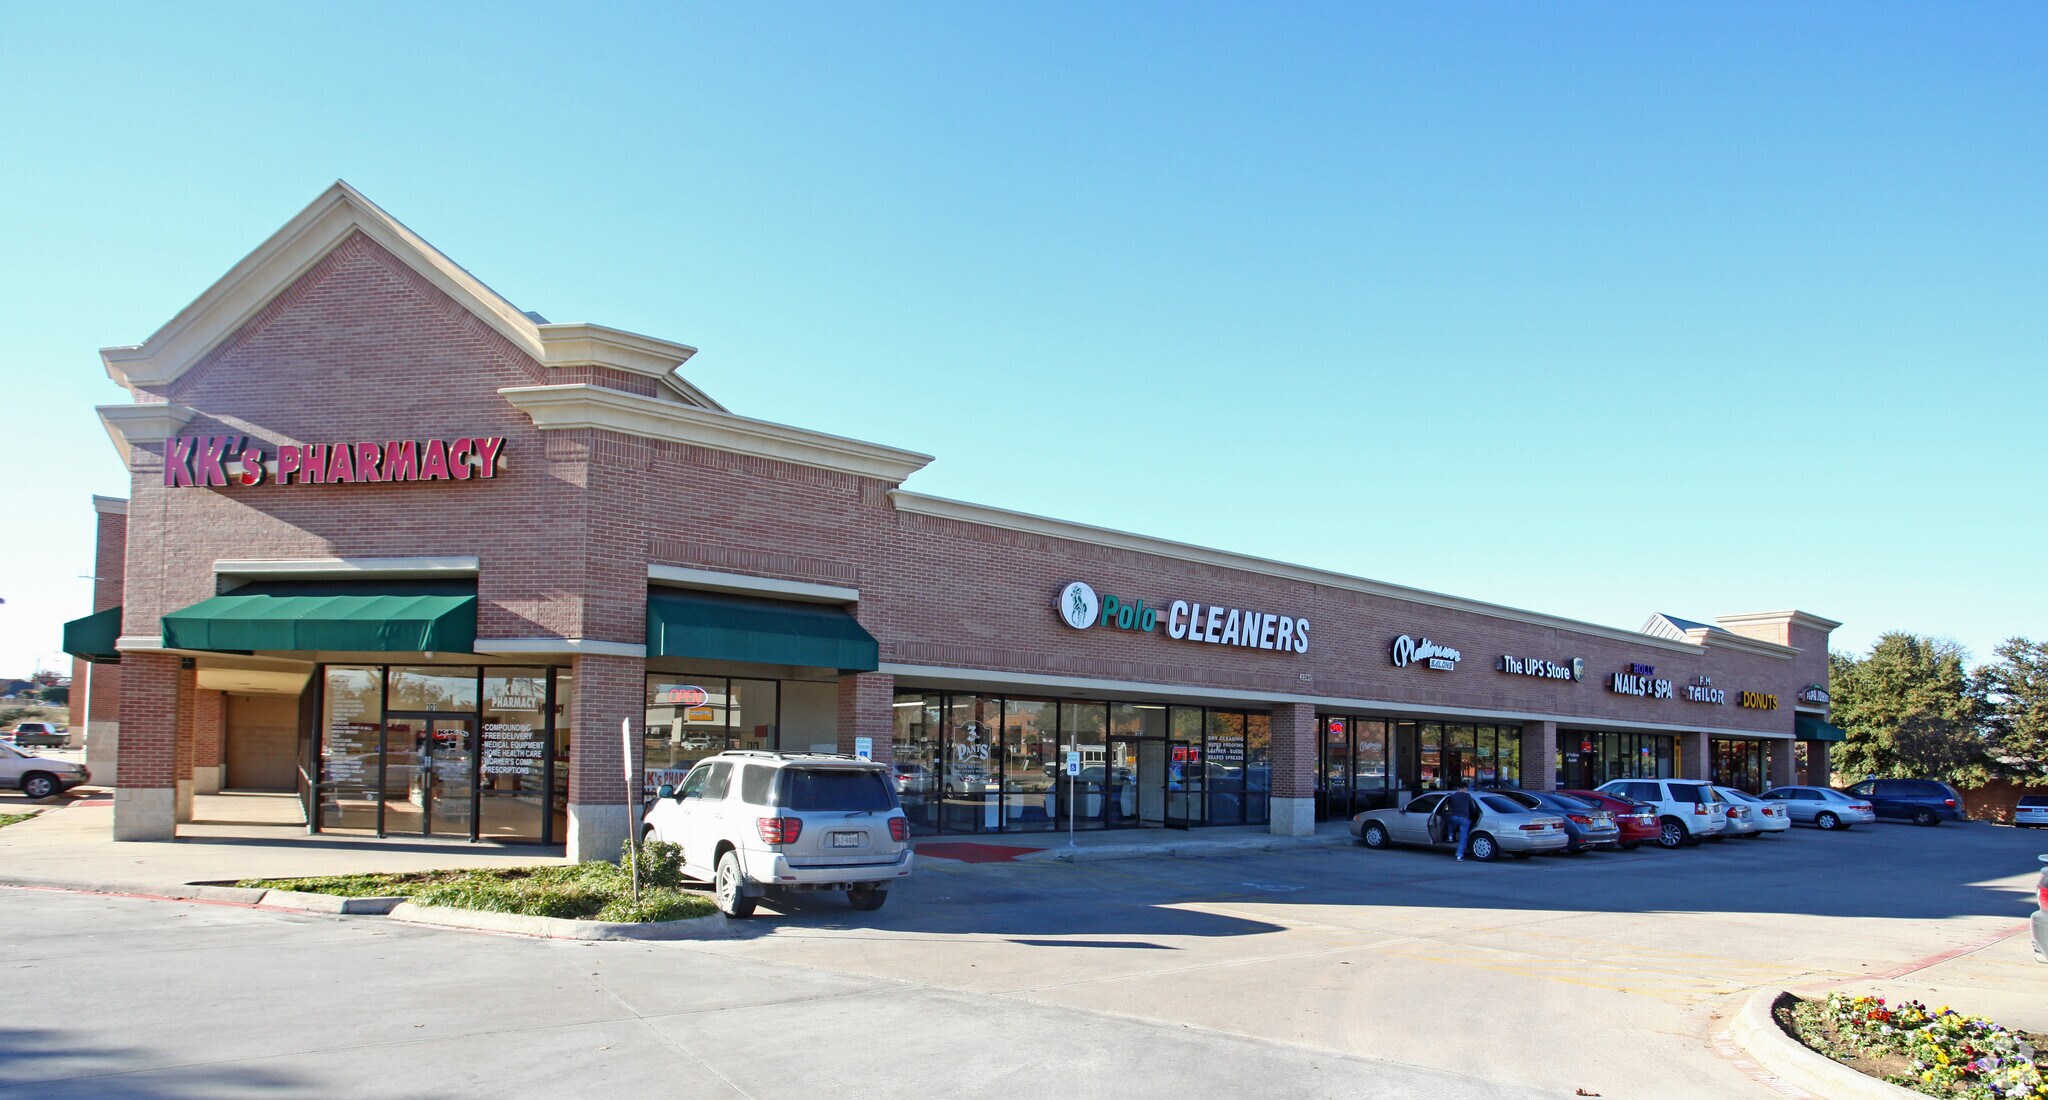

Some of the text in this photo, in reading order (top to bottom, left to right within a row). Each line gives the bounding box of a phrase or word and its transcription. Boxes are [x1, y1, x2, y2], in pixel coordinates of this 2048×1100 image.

[164, 435, 504, 487] KK's PHARMACY
[1101, 594, 1310, 654] Polo CLEANERS
[1394, 635, 1460, 667] Platinum
[1430, 660, 1453, 669] SALONS
[1504, 655, 1571, 679] The UPS Store
[1634, 664, 1655, 675] HOLLY
[1614, 673, 1672, 699] NAILS & SPA
[1699, 676, 1713, 686] F.H.
[491, 696, 537, 708] PHARMACY
[669, 688, 703, 704] OPEN
[1688, 685, 1725, 705] TAILOR
[1743, 691, 1778, 710] DONUTS
[426, 703, 437, 712] 101
[502, 732, 533, 740] DELIVERY
[967, 725, 978, 742] 3
[510, 741, 545, 750] EQUIPMENT
[956, 743, 988, 760] PANTS
[502, 749, 525, 757] HEALTH
[525, 750, 542, 758] CARE
[1173, 748, 1198, 761] OPN
[515, 758, 533, 766] COMP
